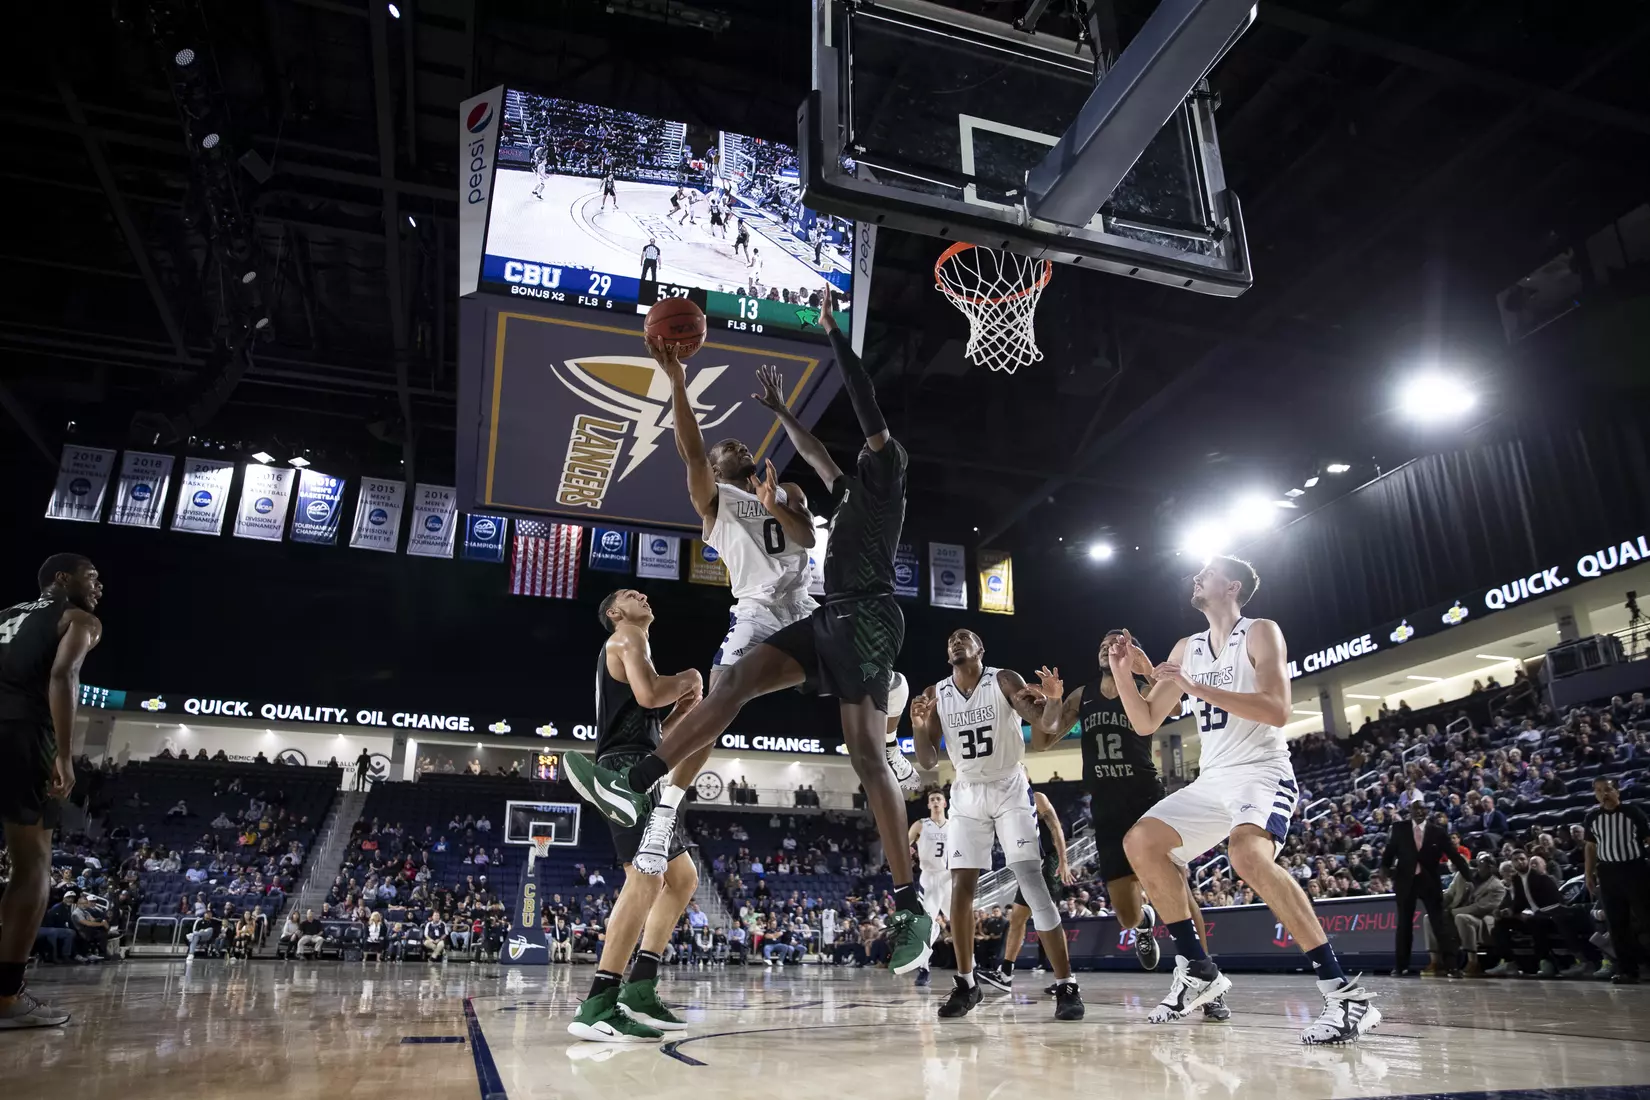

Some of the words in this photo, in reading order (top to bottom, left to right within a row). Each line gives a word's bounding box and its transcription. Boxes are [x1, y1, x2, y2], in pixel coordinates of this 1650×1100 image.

[468, 138, 487, 204] pepsi
[860, 223, 872, 278] peps
[504, 261, 562, 289] CBU
[588, 273, 612, 296] 29
[511, 286, 550, 299] BONUS
[551, 292, 565, 301] X2
[578, 296, 598, 306] FLS
[606, 300, 612, 308] 5
[738, 298, 759, 320] 13
[727, 320, 747, 331] FLS
[751, 324, 763, 334] 10
[133, 458, 162, 468] 2018
[556, 414, 629, 509] LANCERS
[370, 484, 396, 494] 2015
[424, 490, 448, 500] 2014
[360, 500, 400, 508] BASKETBALL
[239, 520, 281, 530] TOURNAMENT
[764, 518, 786, 554] 0
[1485, 566, 1570, 609] QUICK.
[1577, 536, 1650, 577] QUAL
[1287, 662, 1302, 679] IL
[1304, 634, 1378, 672] CHANGE.
[184, 698, 252, 716] QUICK.
[261, 703, 348, 723] QUALITY.
[356, 710, 387, 726] OIL
[392, 712, 474, 732] CHANGE.
[948, 705, 995, 728] LANCERS
[722, 734, 749, 748] OIL
[752, 736, 824, 753] CHANGE.
[958, 726, 993, 760] 35
[1096, 733, 1123, 760] 12
[538, 756, 558, 764] 5:27
[1094, 764, 1134, 778] STATE
[935, 842, 944, 858] 3
[522, 883, 536, 928] CBU
